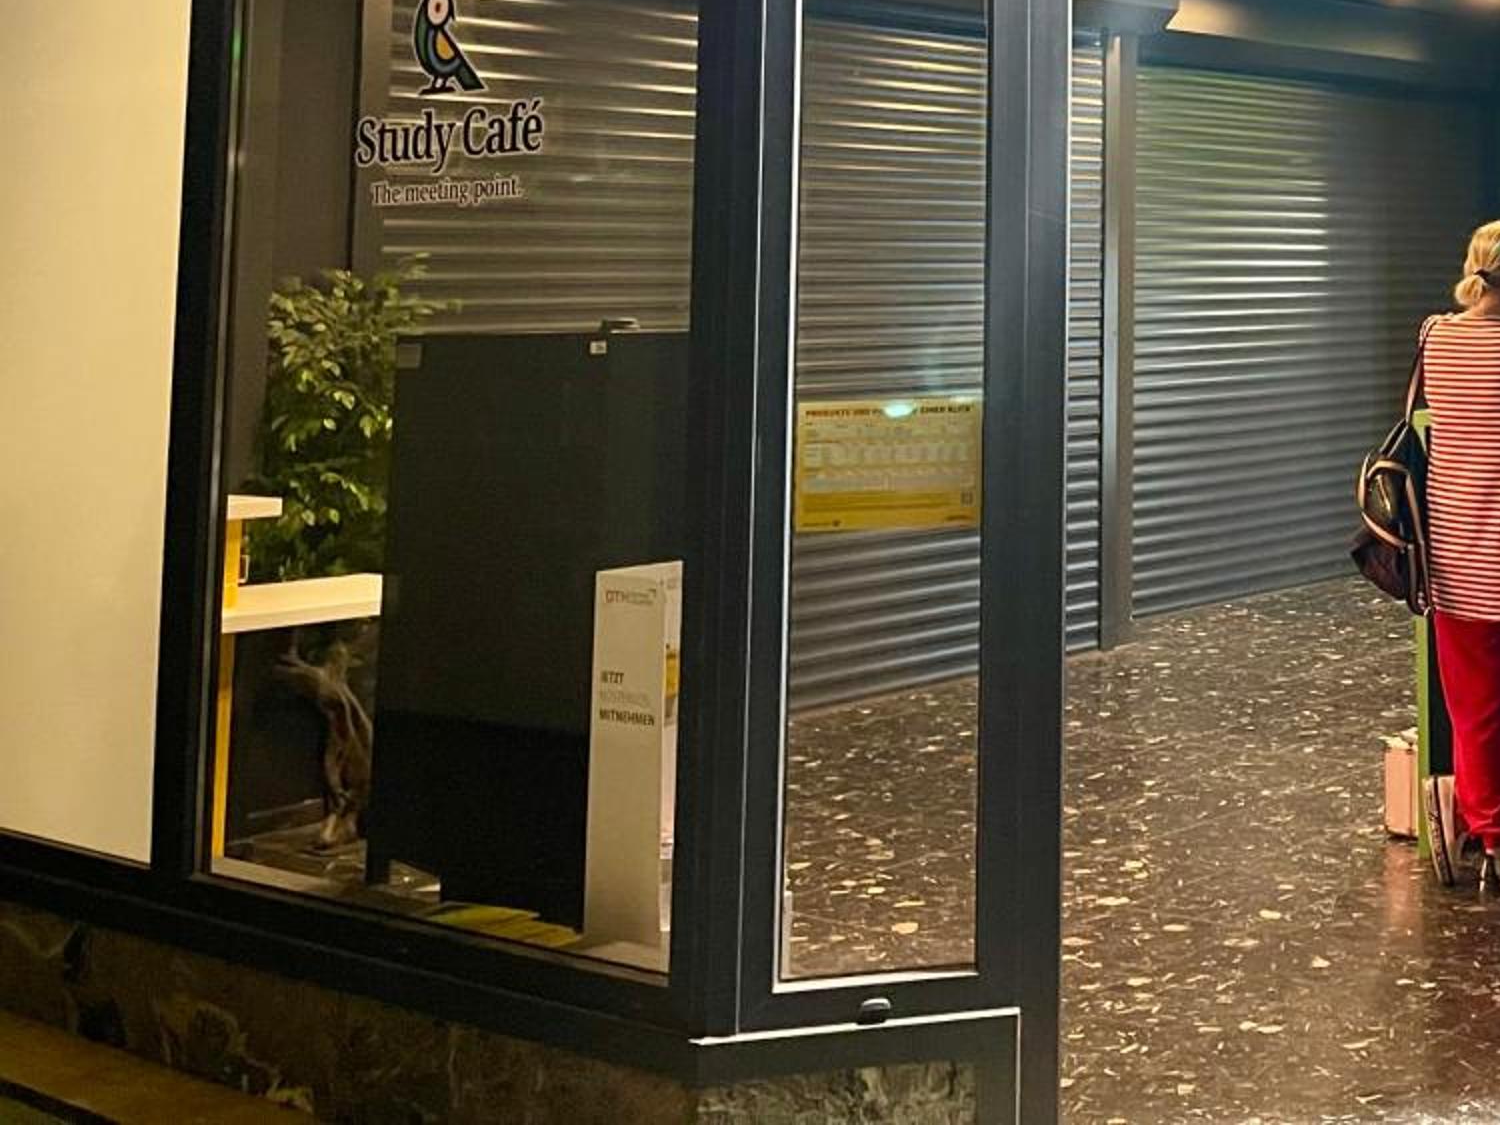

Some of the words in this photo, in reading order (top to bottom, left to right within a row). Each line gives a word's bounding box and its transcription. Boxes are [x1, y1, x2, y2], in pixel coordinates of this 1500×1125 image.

[356, 109, 457, 175] Study
[462, 97, 543, 157] Café
[372, 183, 401, 206] The
[404, 179, 469, 206] meeting
[474, 178, 522, 205] point.
